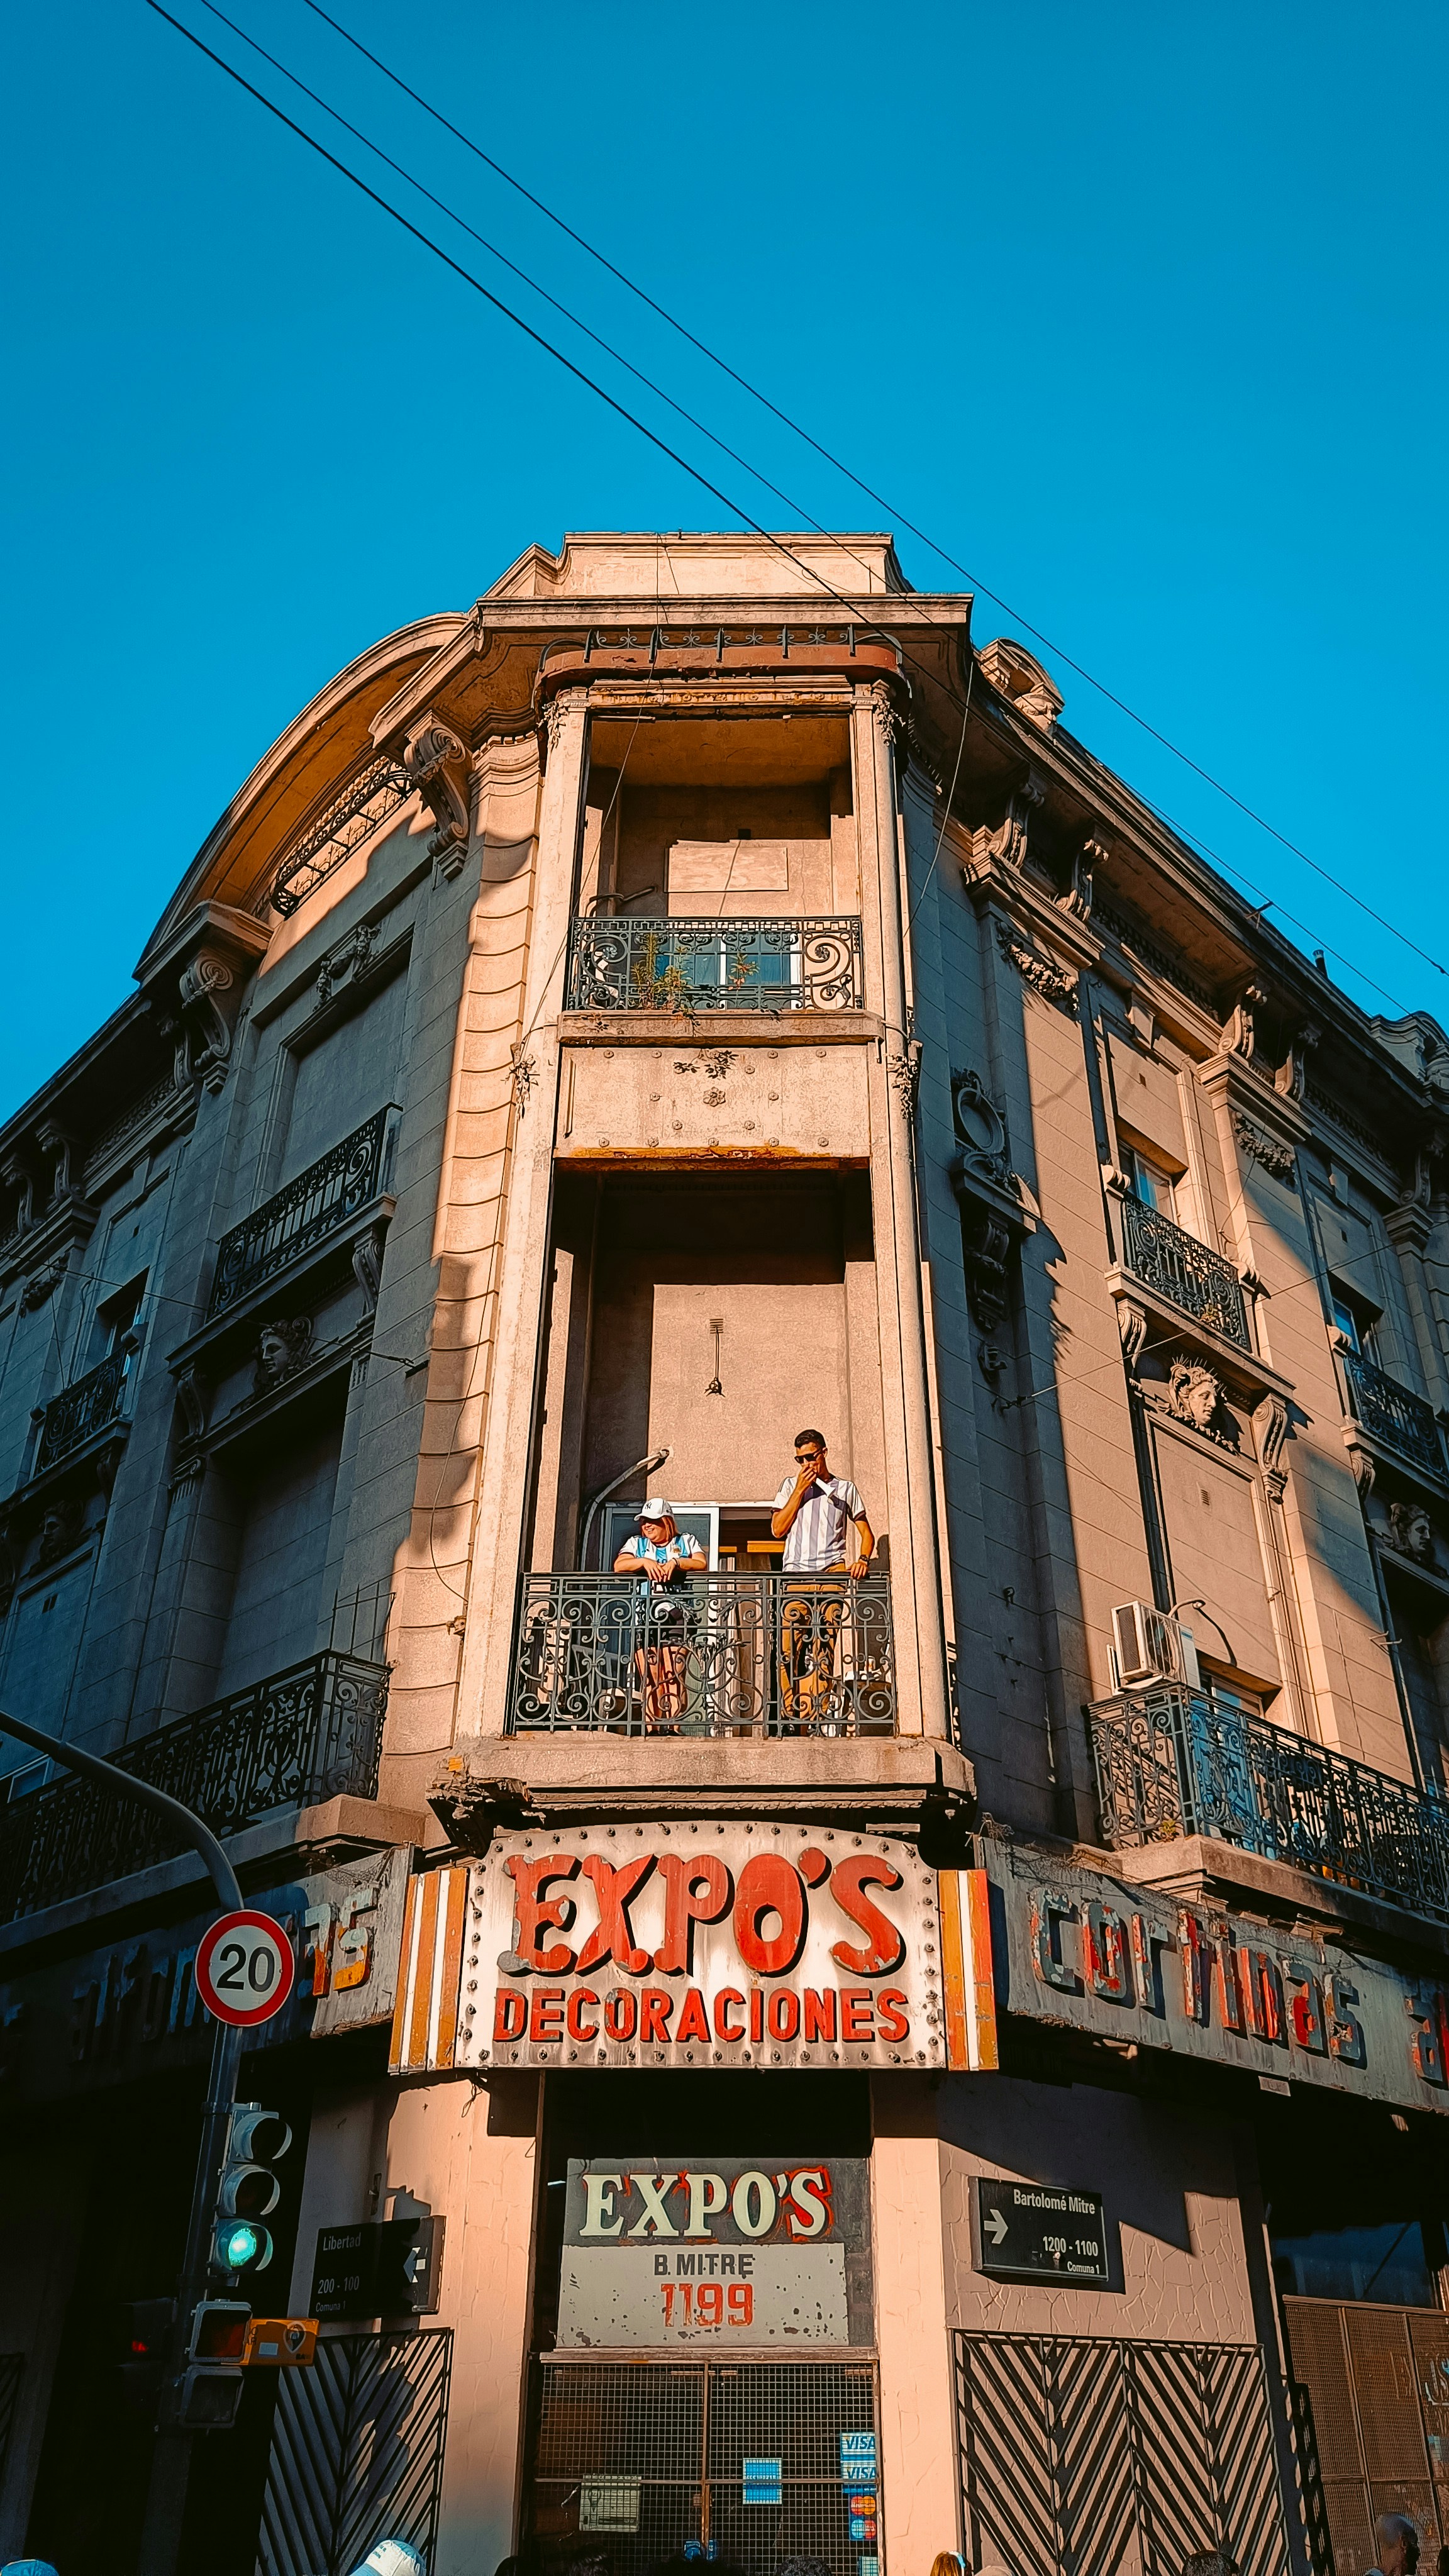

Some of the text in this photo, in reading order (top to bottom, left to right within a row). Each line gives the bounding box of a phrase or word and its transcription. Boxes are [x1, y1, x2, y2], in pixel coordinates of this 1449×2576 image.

[497, 1848, 906, 1979] EXPO'S
[217, 1943, 275, 1992] 20
[493, 1987, 910, 2043] DECORACIONES
[579, 2170, 828, 2238] EXPO'S
[1013, 2189, 1096, 2214] Bartolomé Mitre
[323, 2232, 361, 2251] Libertad
[1043, 2236, 1067, 2253] 1200
[1075, 2240, 1099, 2257] 1100
[1067, 2262, 1099, 2274] Comuna 1
[318, 2279, 335, 2294] 200
[343, 2275, 360, 2290] 100
[316, 2302, 340, 2312] Comuna
[660, 2283, 753, 2327] 1199
[846, 2436, 875, 2450] VISA
[847, 2467, 876, 2479] VISA
